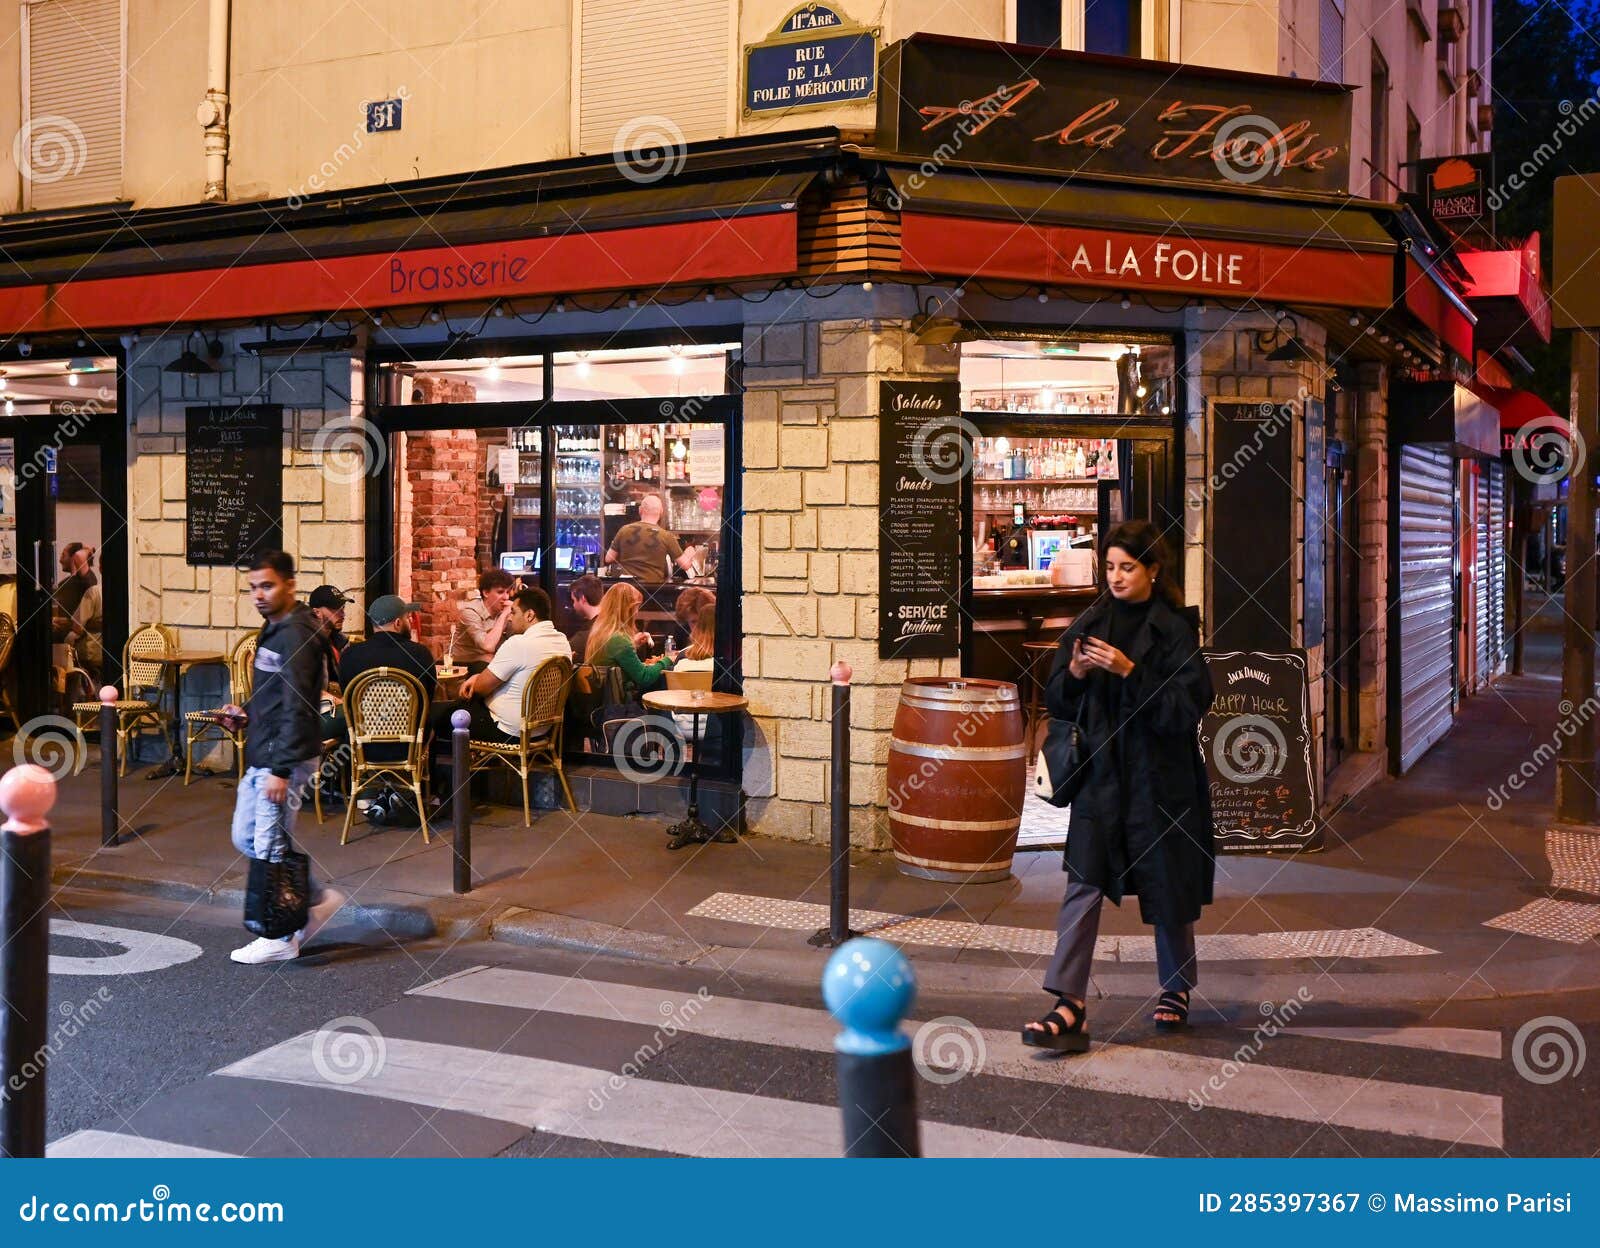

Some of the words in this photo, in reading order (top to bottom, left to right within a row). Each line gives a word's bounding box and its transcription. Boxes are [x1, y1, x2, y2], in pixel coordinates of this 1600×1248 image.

[795, 46, 825, 62] RUE
[787, 67, 806, 81] DE
[814, 63, 832, 78] LA
[752, 86, 791, 103] FOLIE
[795, 76, 868, 98] MÉRICOURT
[374, 103, 394, 129] 51
[1434, 195, 1476, 208] BLASON
[1071, 243, 1092, 273] A
[1105, 240, 1142, 276] LA
[1155, 242, 1243, 285] FOLIE
[390, 254, 528, 293] Brasserie
[891, 393, 943, 412] Salades
[895, 476, 933, 492] Snacks
[897, 602, 948, 620] SERVICE
[1227, 668, 1245, 686] JACK
[1210, 693, 1248, 711] HAPPY
[1251, 694, 1290, 712] HOUR
